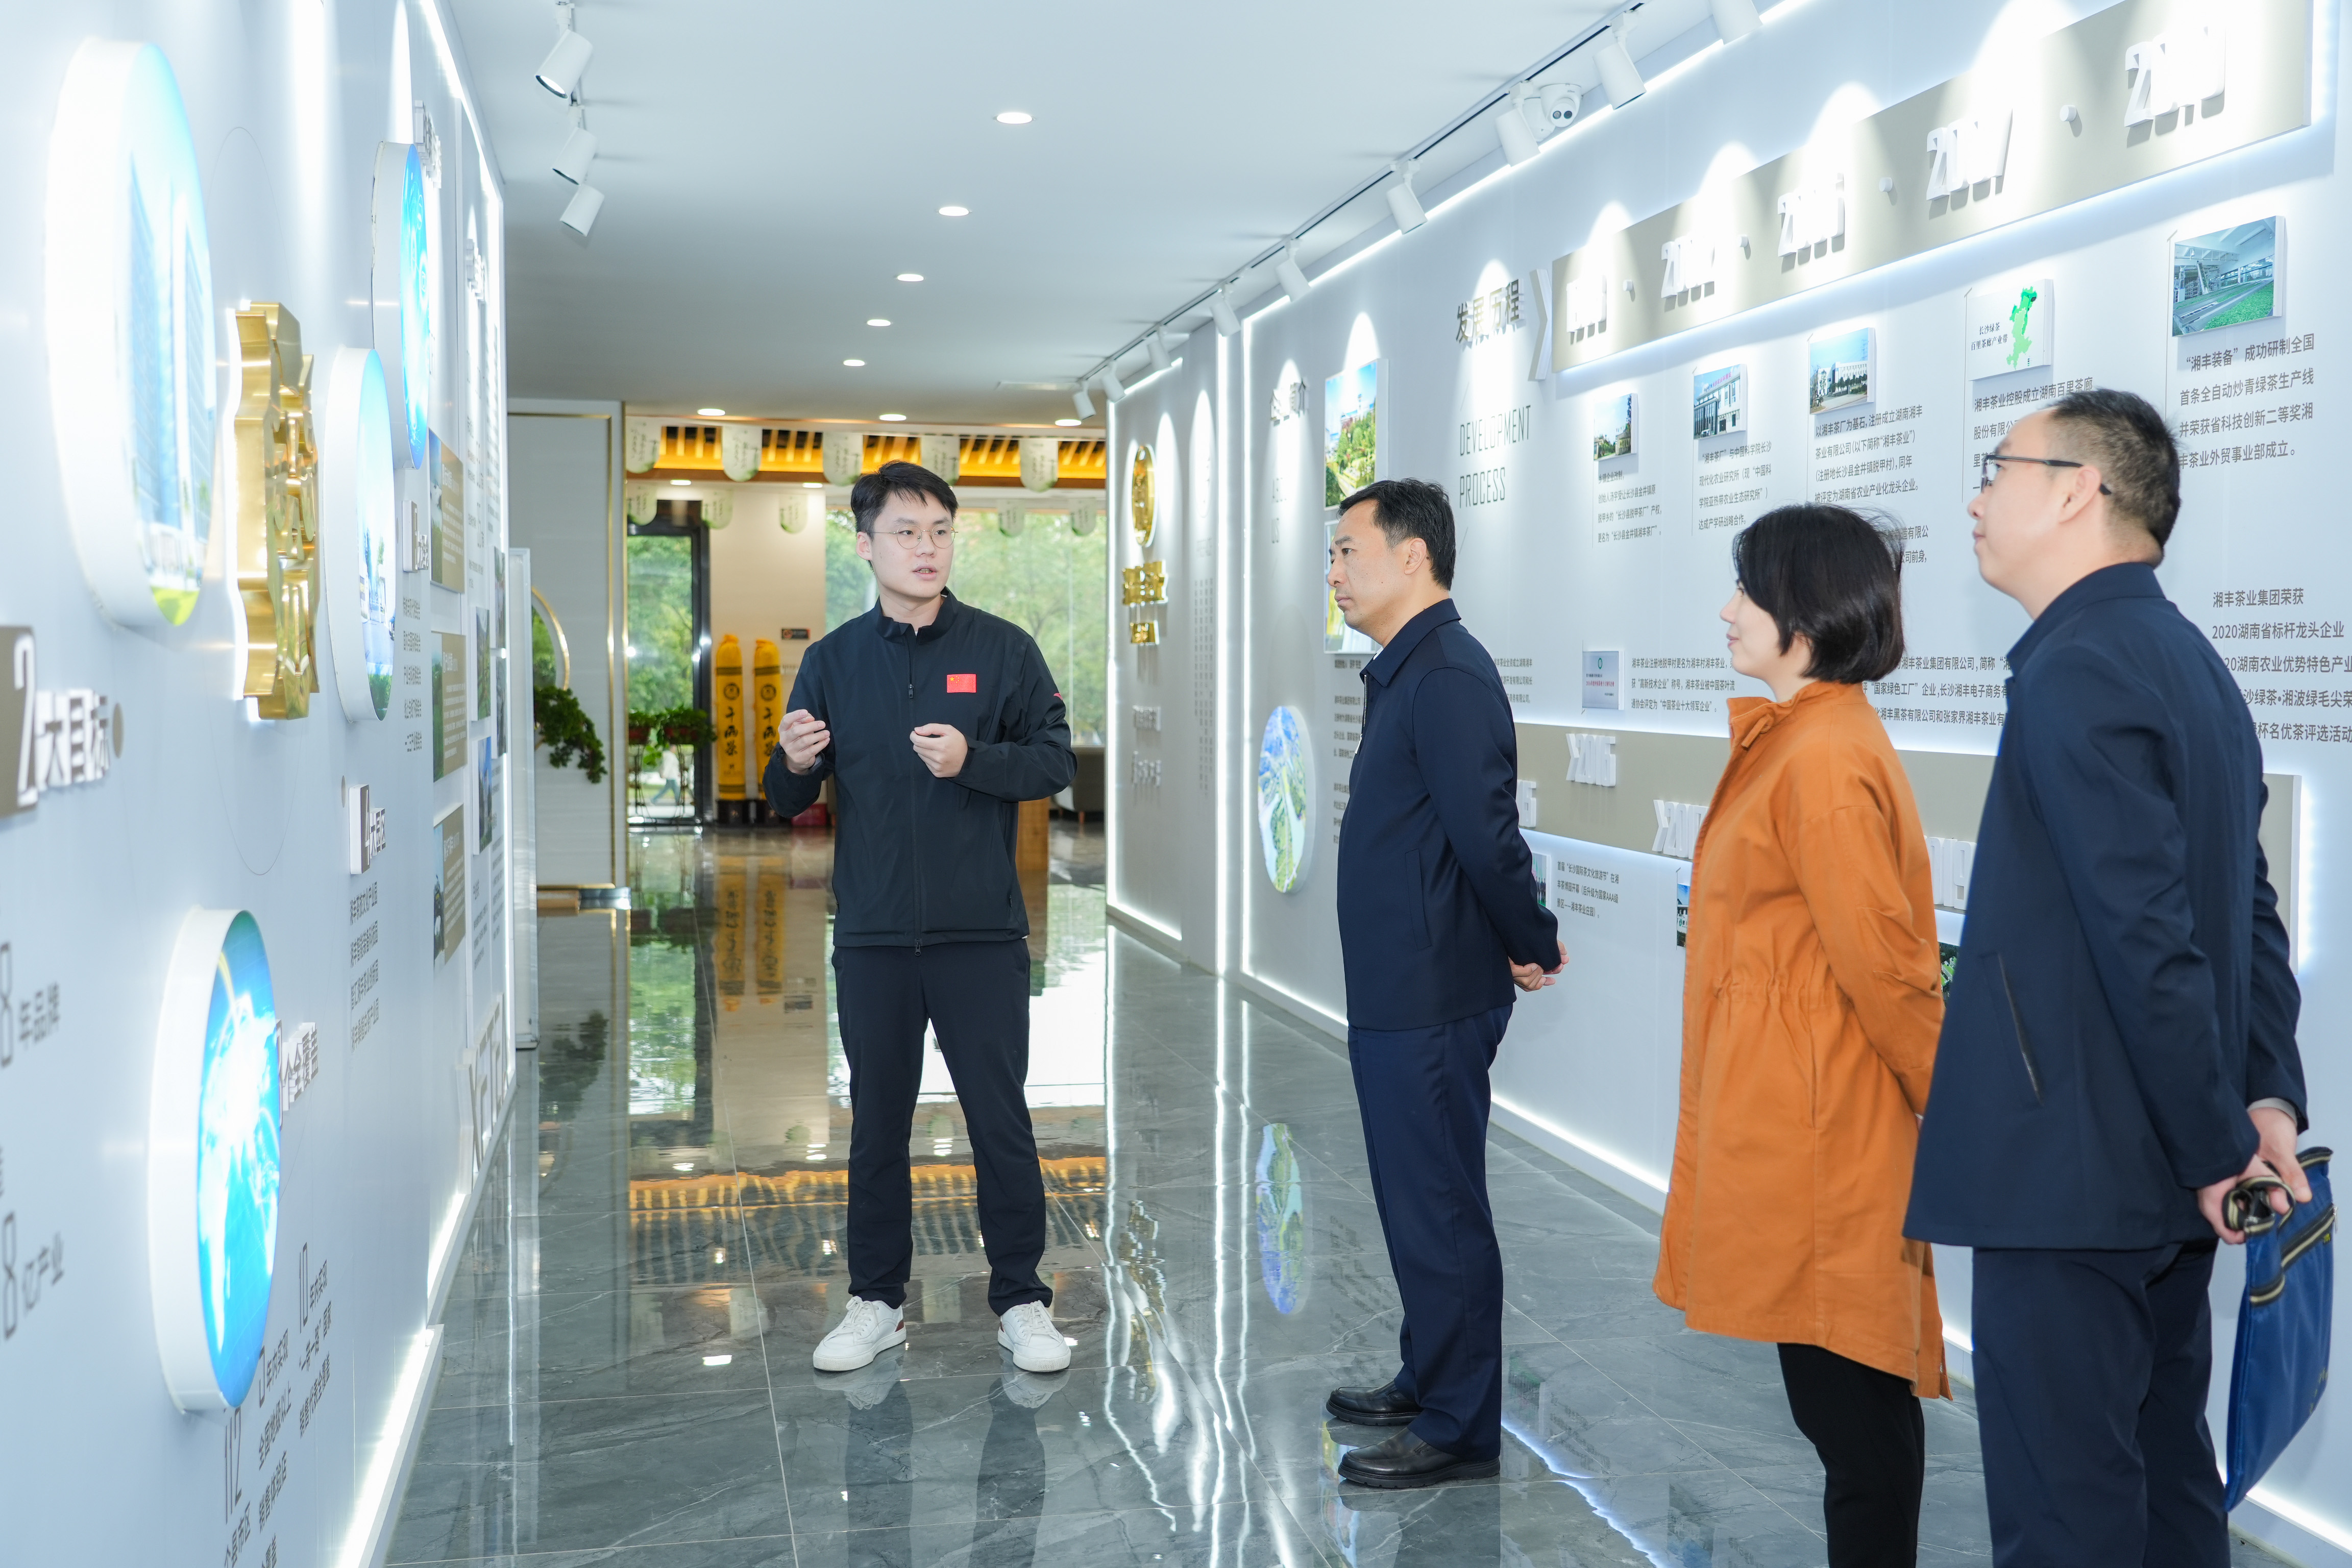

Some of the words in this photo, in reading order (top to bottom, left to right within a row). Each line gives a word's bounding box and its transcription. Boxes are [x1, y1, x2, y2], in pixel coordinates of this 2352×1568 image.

[1456, 278, 1521, 344] 发展历程
[1979, 322, 2000, 335] 长沙绿茶
[1971, 334, 2008, 351] 百里茶廊产业带
[2180, 367, 2314, 407] 首条全自动炒青绿茶生产线
[1459, 404, 1531, 457] DEVELOPMENT
[1973, 420, 2020, 440] 股份有限公
[2179, 402, 2314, 438] 并荣获省科技创新二等奖湘
[1459, 467, 1506, 509] PROCESS
[2213, 587, 2304, 608] 湘丰茶业集团荣获
[2212, 621, 2344, 640] 2020湖南省标杆龙头企业
[2240, 689, 2352, 708] 沙绿茶·湘波绿毛尖荣
[14, 634, 111, 807] 2大目标
[299, 1351, 330, 1439] 销售代表全覆盖
[259, 1380, 291, 1471] 全国地级以上
[259, 1449, 287, 1534] 销售体验店
